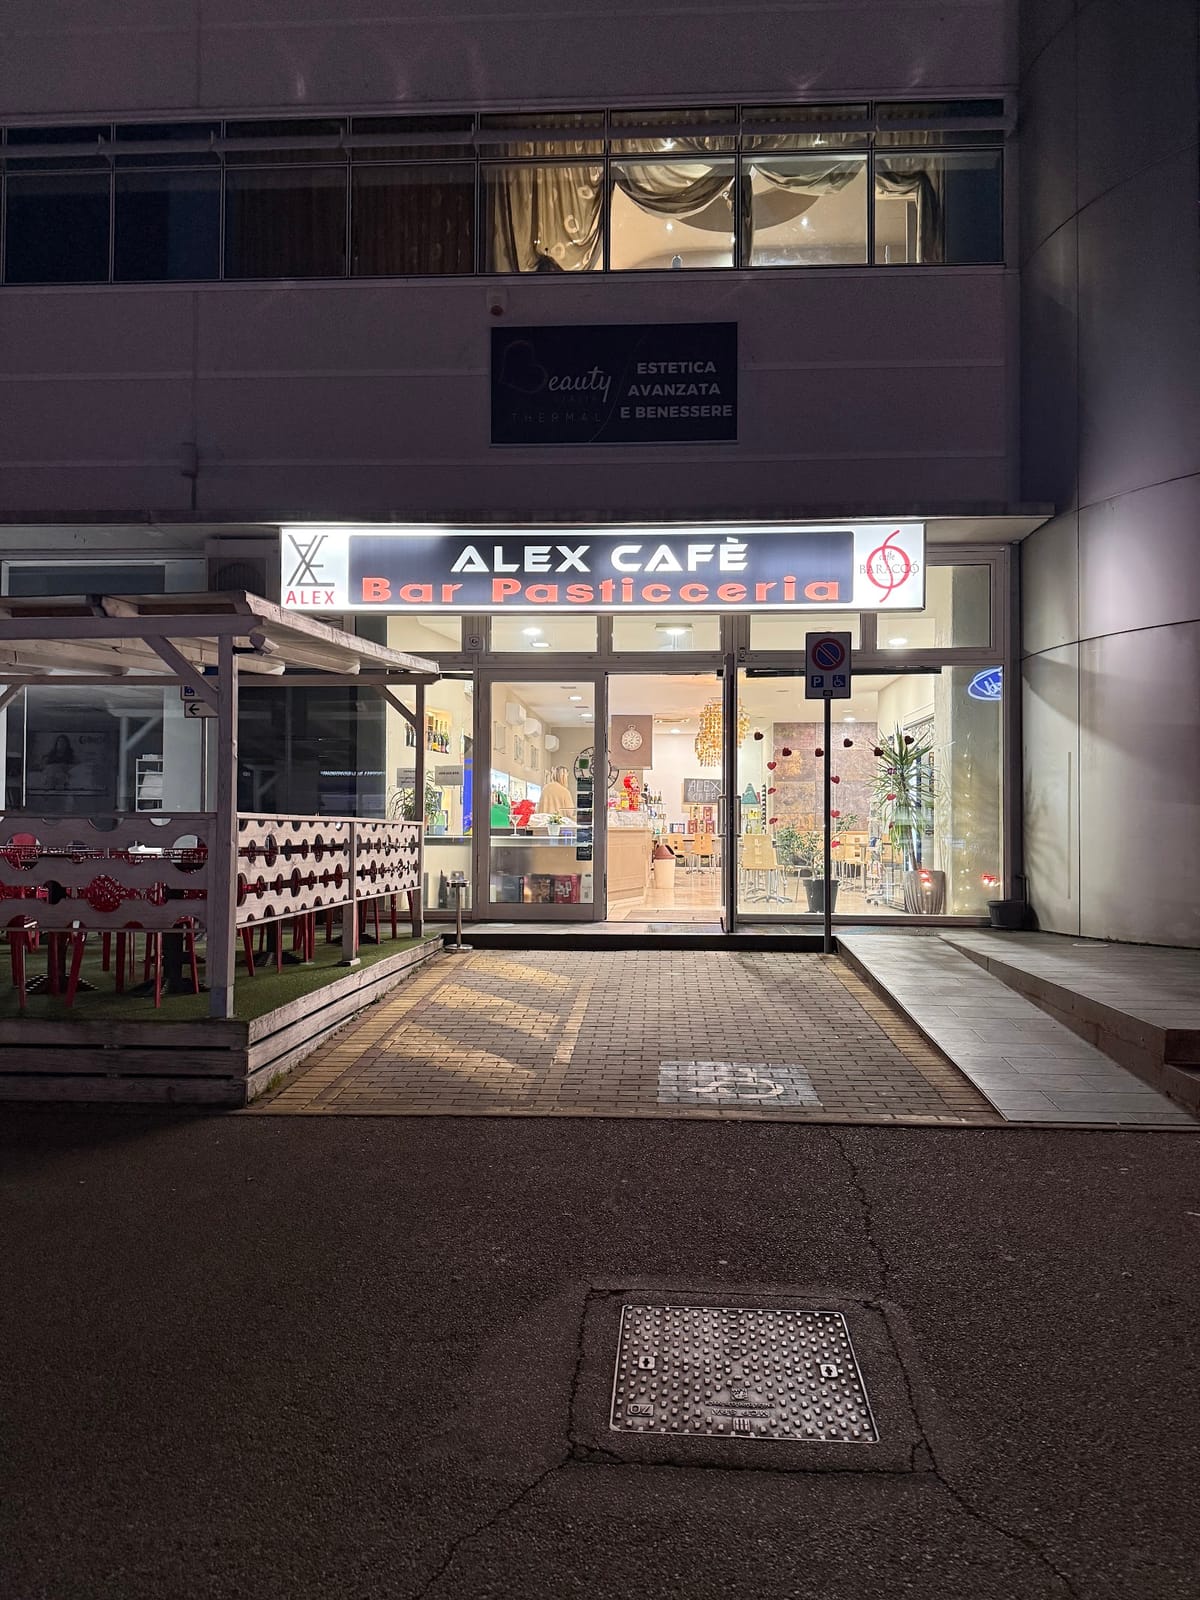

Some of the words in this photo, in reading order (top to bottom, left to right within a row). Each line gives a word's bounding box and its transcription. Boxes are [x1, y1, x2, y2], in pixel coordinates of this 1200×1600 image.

[637, 361, 717, 375] ESTETICA
[628, 383, 721, 397] AVANZATA
[620, 407, 630, 419] E
[635, 405, 733, 419] BENESSERE
[450, 545, 591, 573] ALEX
[610, 537, 749, 572] CAFÈ
[362, 577, 463, 603] Bar
[492, 576, 841, 604] Pasticceria
[286, 591, 335, 605] ALEX
